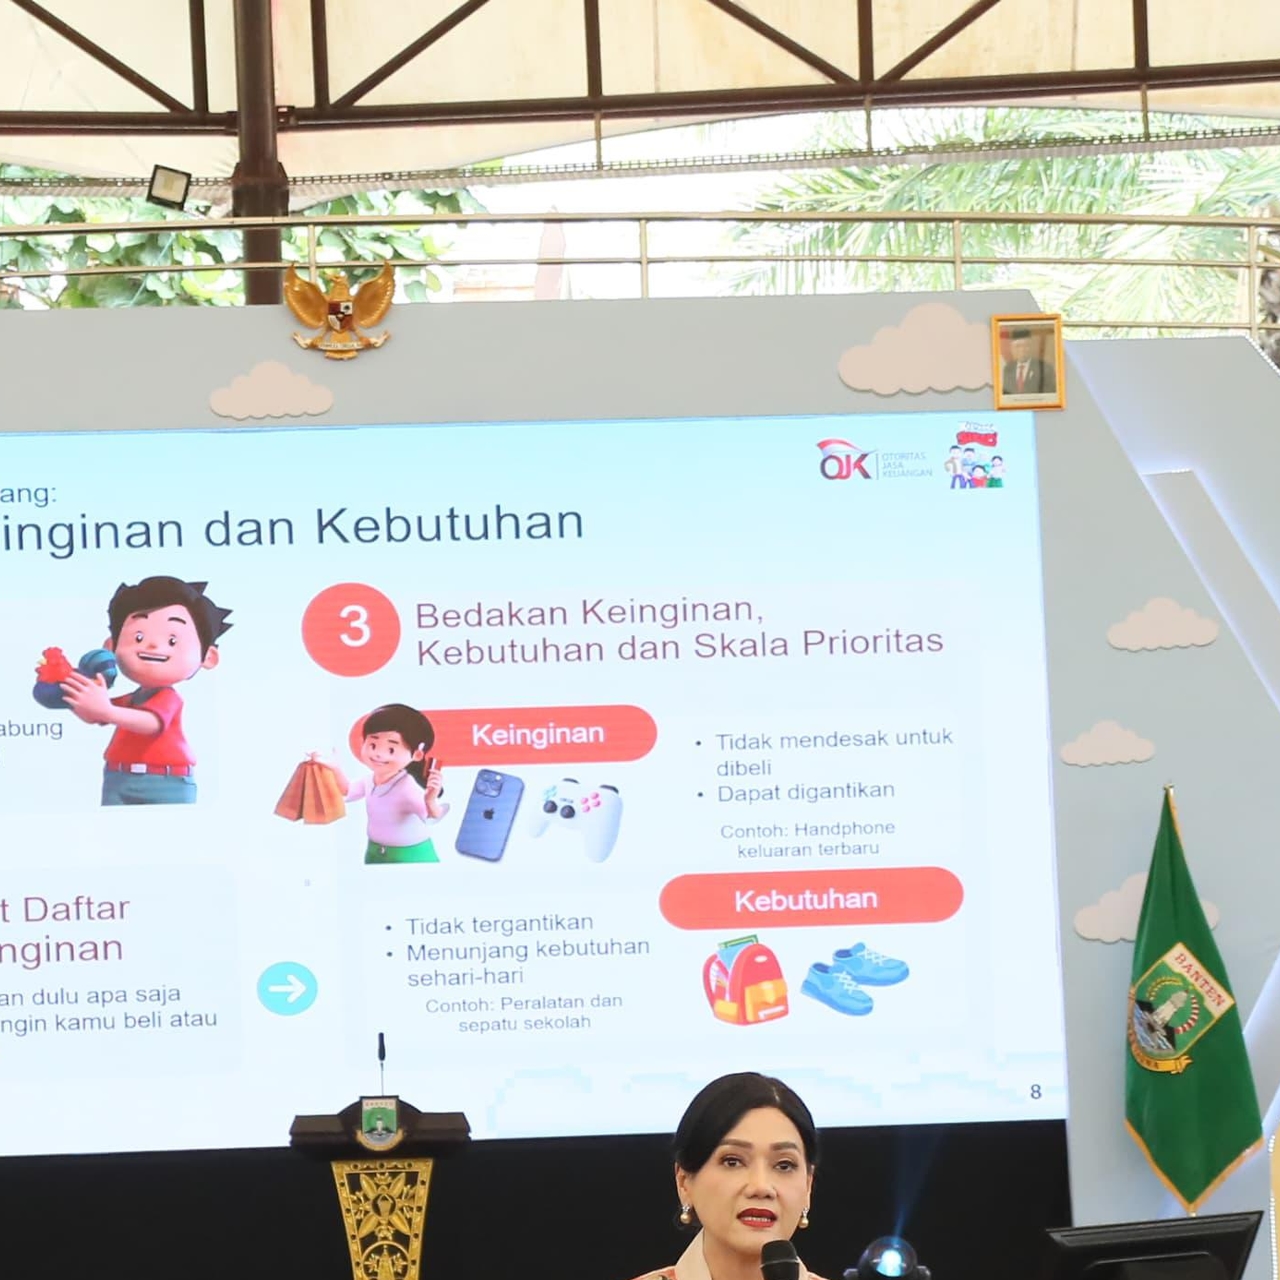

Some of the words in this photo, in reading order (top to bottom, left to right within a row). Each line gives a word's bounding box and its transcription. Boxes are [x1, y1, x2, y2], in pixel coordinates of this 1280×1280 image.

[204, 510, 294, 547] dan
[316, 504, 583, 544] Kebutuhan
[416, 601, 567, 629] Bedakan
[582, 596, 763, 629] Keinginan,
[339, 604, 371, 647] 3
[418, 637, 604, 666] Kebutuhan
[617, 634, 680, 661] dan
[694, 631, 789, 659] Skala
[803, 628, 944, 656] Prioritas
[472, 722, 605, 750] Keinginan
[715, 733, 773, 751] Tidak
[780, 729, 889, 749] mendesak
[896, 727, 953, 746] untuk
[716, 759, 772, 777] dibeli
[718, 784, 781, 806] Dapat
[787, 782, 895, 804] digantikan
[720, 823, 789, 839] Contoh:
[794, 821, 896, 839] Handphone
[737, 844, 812, 859] keluaran
[818, 841, 880, 856] terbaru
[23, 895, 131, 923] Daftar
[735, 887, 878, 913] Kebutuhan
[405, 917, 465, 936] Tidak
[472, 913, 593, 938] tergantikan
[407, 944, 529, 964] Menunjang
[536, 937, 650, 957] kebutuhan
[407, 967, 524, 987] sehari-hari
[1174, 953, 1226, 1007] BANTEN
[31, 987, 79, 1006] dulu
[86, 989, 128, 1008] apa
[135, 984, 182, 1008] saja
[425, 997, 495, 1014] Contoh:
[500, 996, 585, 1011] Peralatan
[590, 993, 623, 1008] dan
[55, 1014, 116, 1032] kamu
[123, 1011, 162, 1029] beli
[169, 1011, 217, 1028] atau
[458, 1018, 518, 1035] sepatu
[524, 1014, 591, 1030] sekolah
[1030, 1083, 1042, 1100] 8
